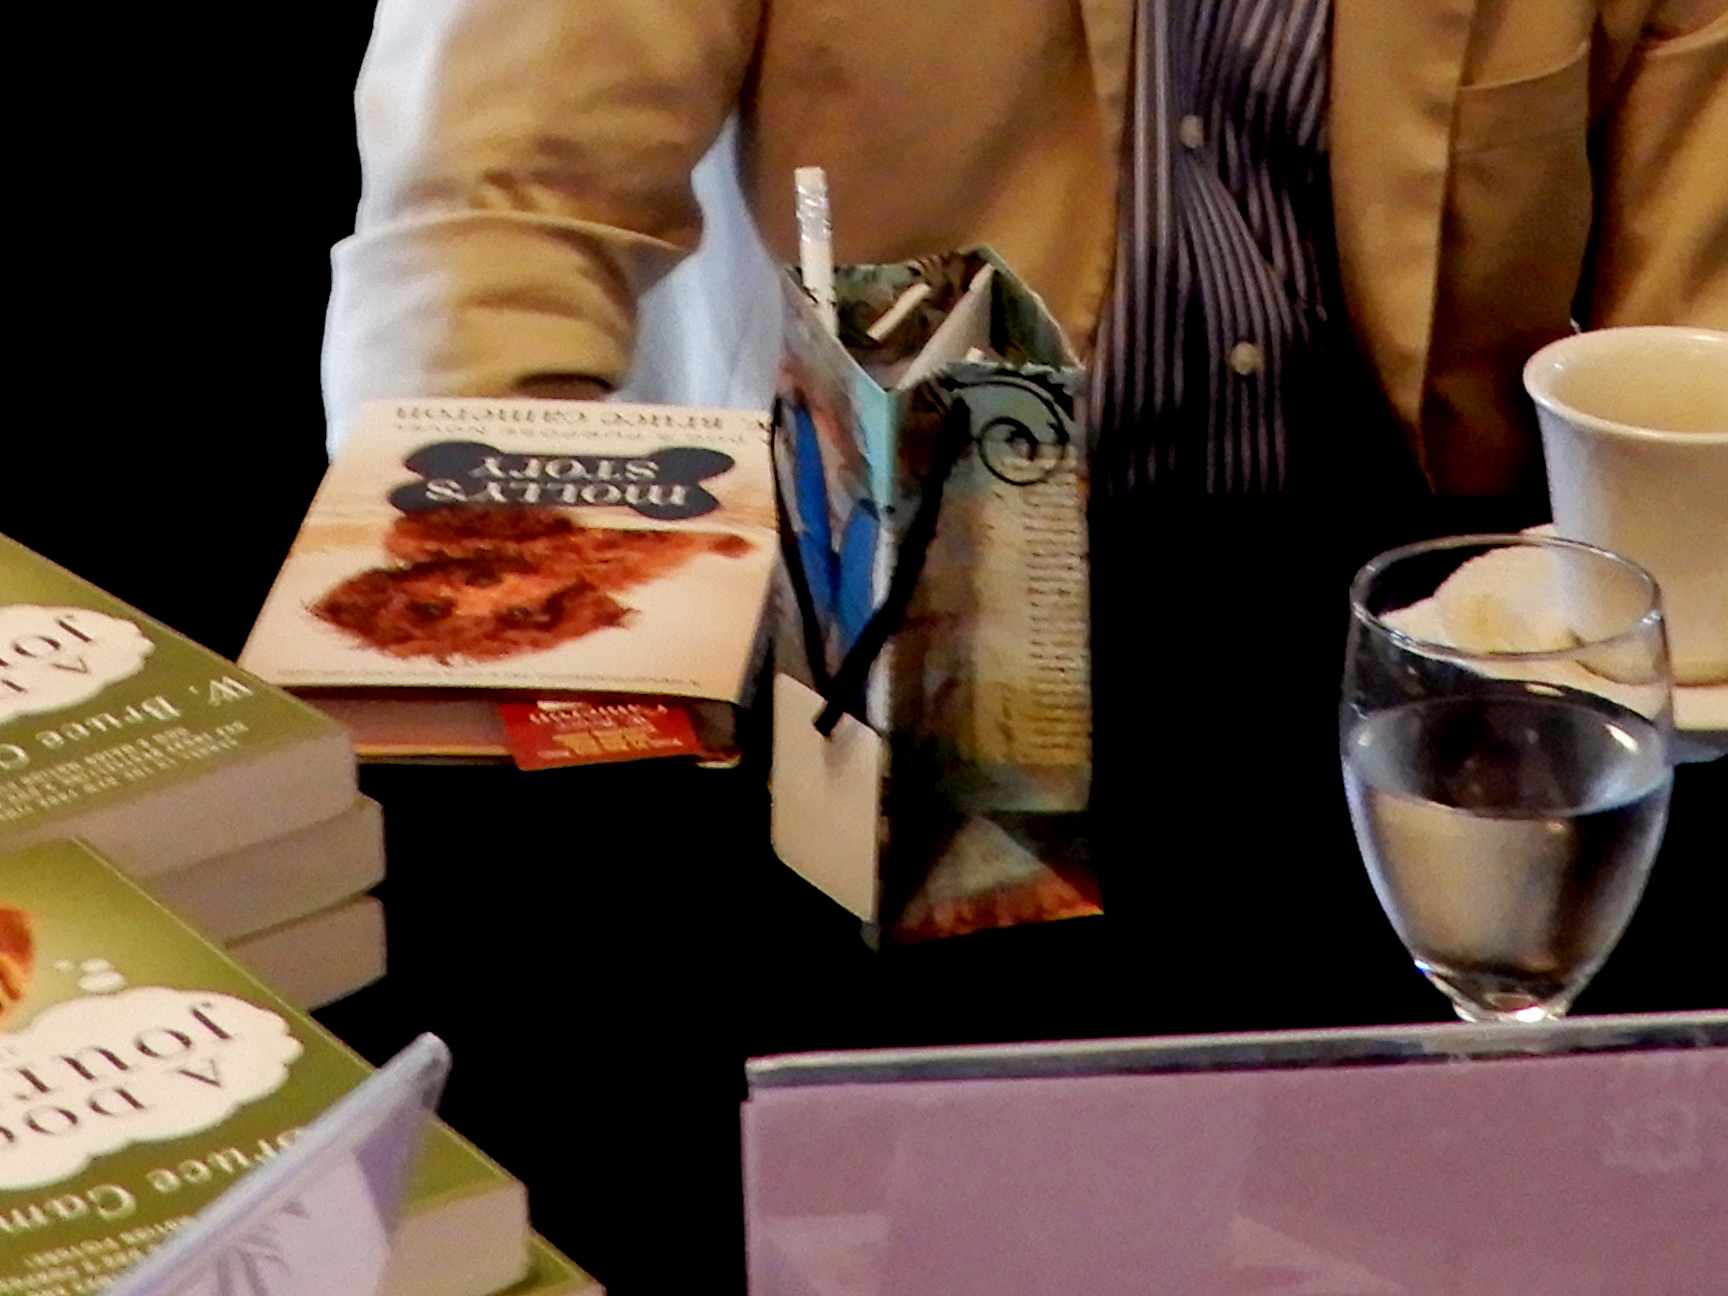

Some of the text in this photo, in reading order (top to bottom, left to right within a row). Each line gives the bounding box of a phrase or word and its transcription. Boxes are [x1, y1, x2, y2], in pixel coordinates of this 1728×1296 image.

[52, 656, 92, 676] A
[35, 696, 181, 750] Bruce
[178, 1057, 226, 1089] A
